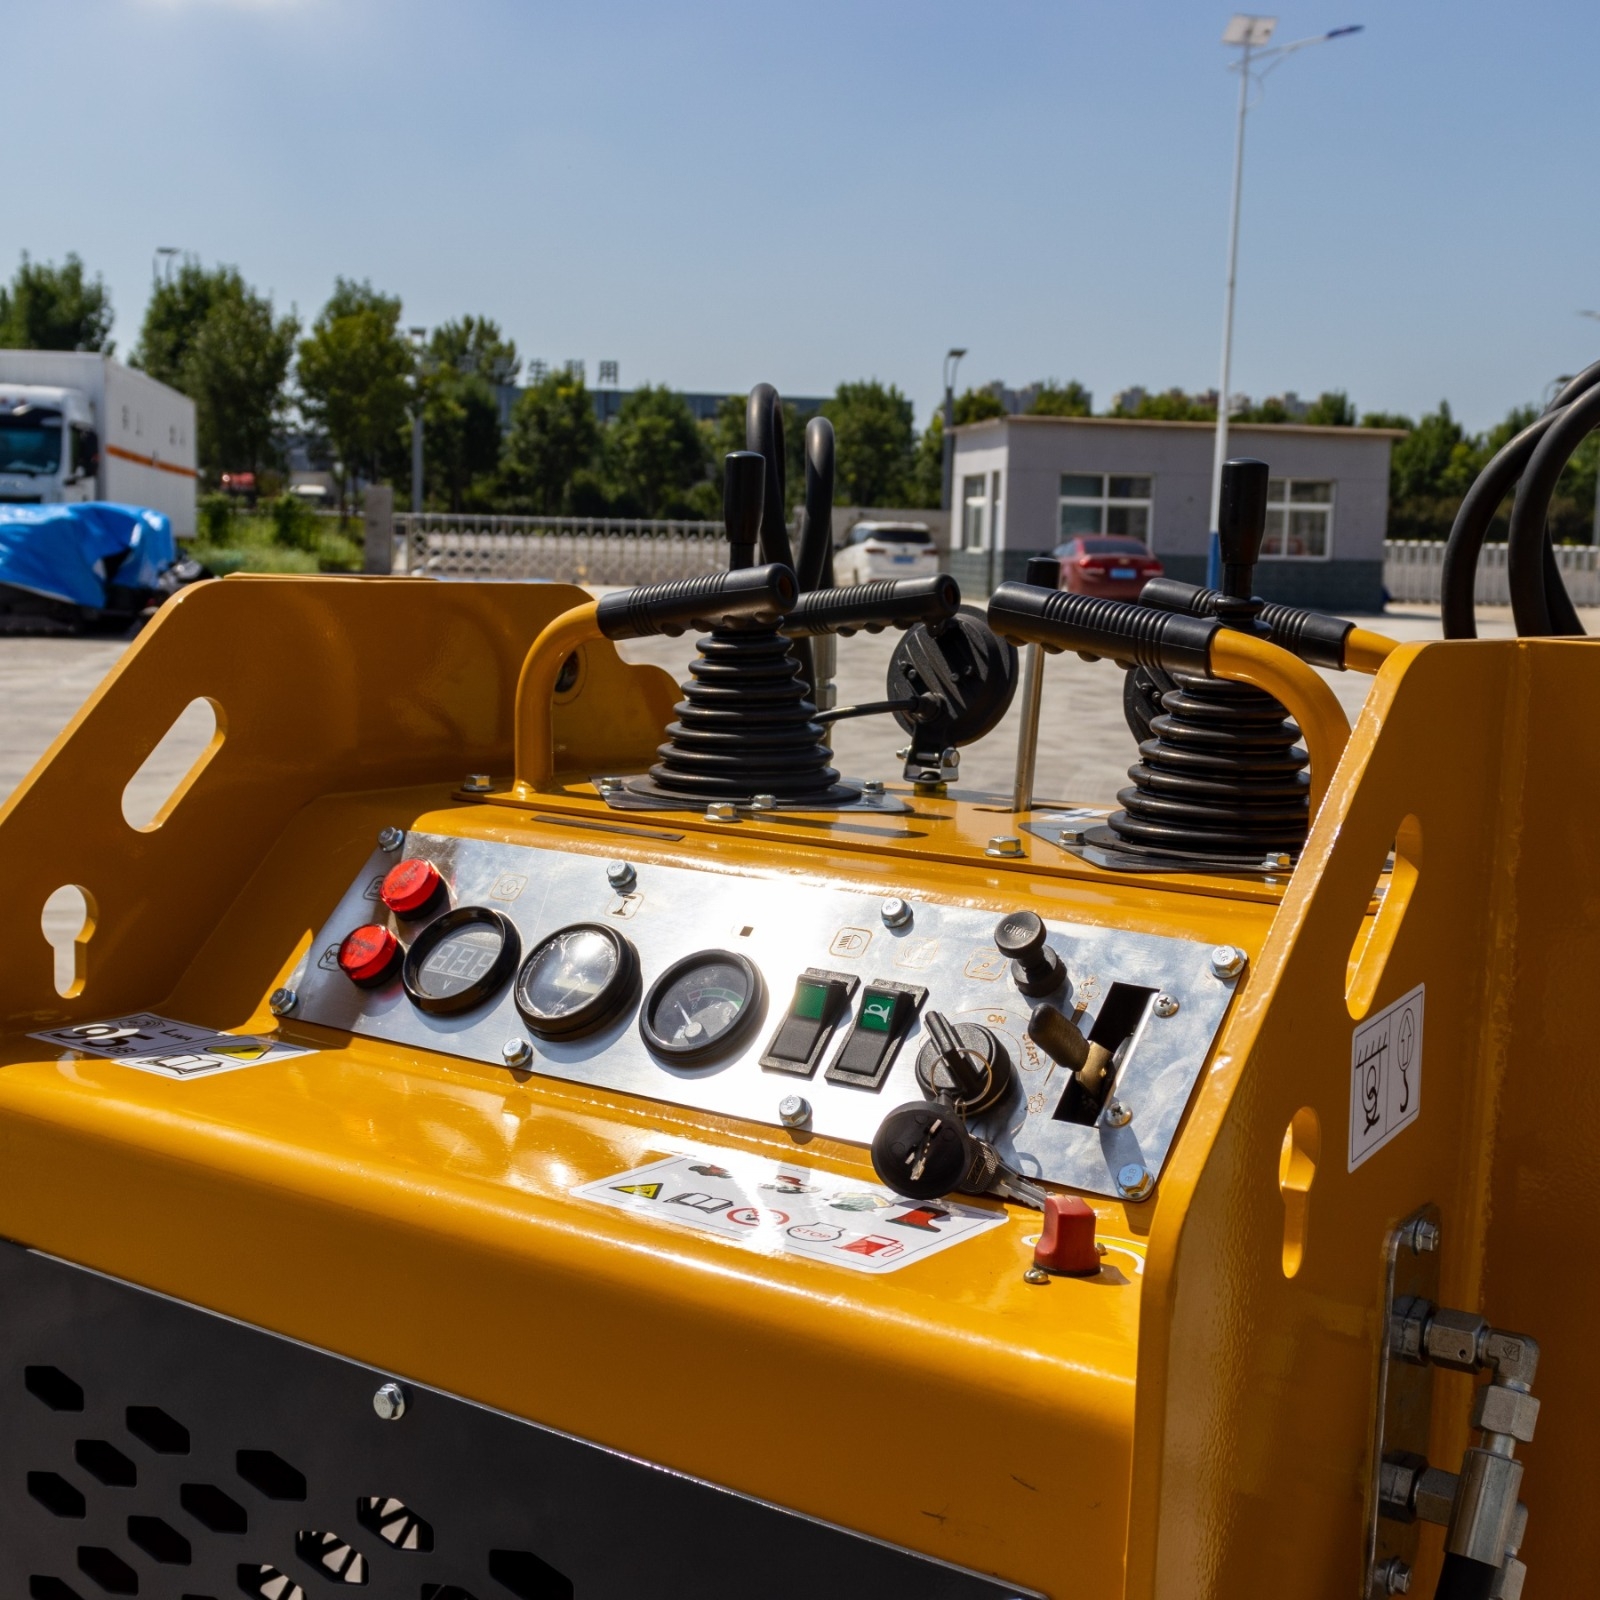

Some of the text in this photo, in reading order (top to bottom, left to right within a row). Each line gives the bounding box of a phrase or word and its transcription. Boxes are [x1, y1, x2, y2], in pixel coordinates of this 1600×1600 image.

[1003, 923, 1034, 939] CHOKE
[987, 1014, 1006, 1025] ON
[793, 1227, 832, 1239] STOP
